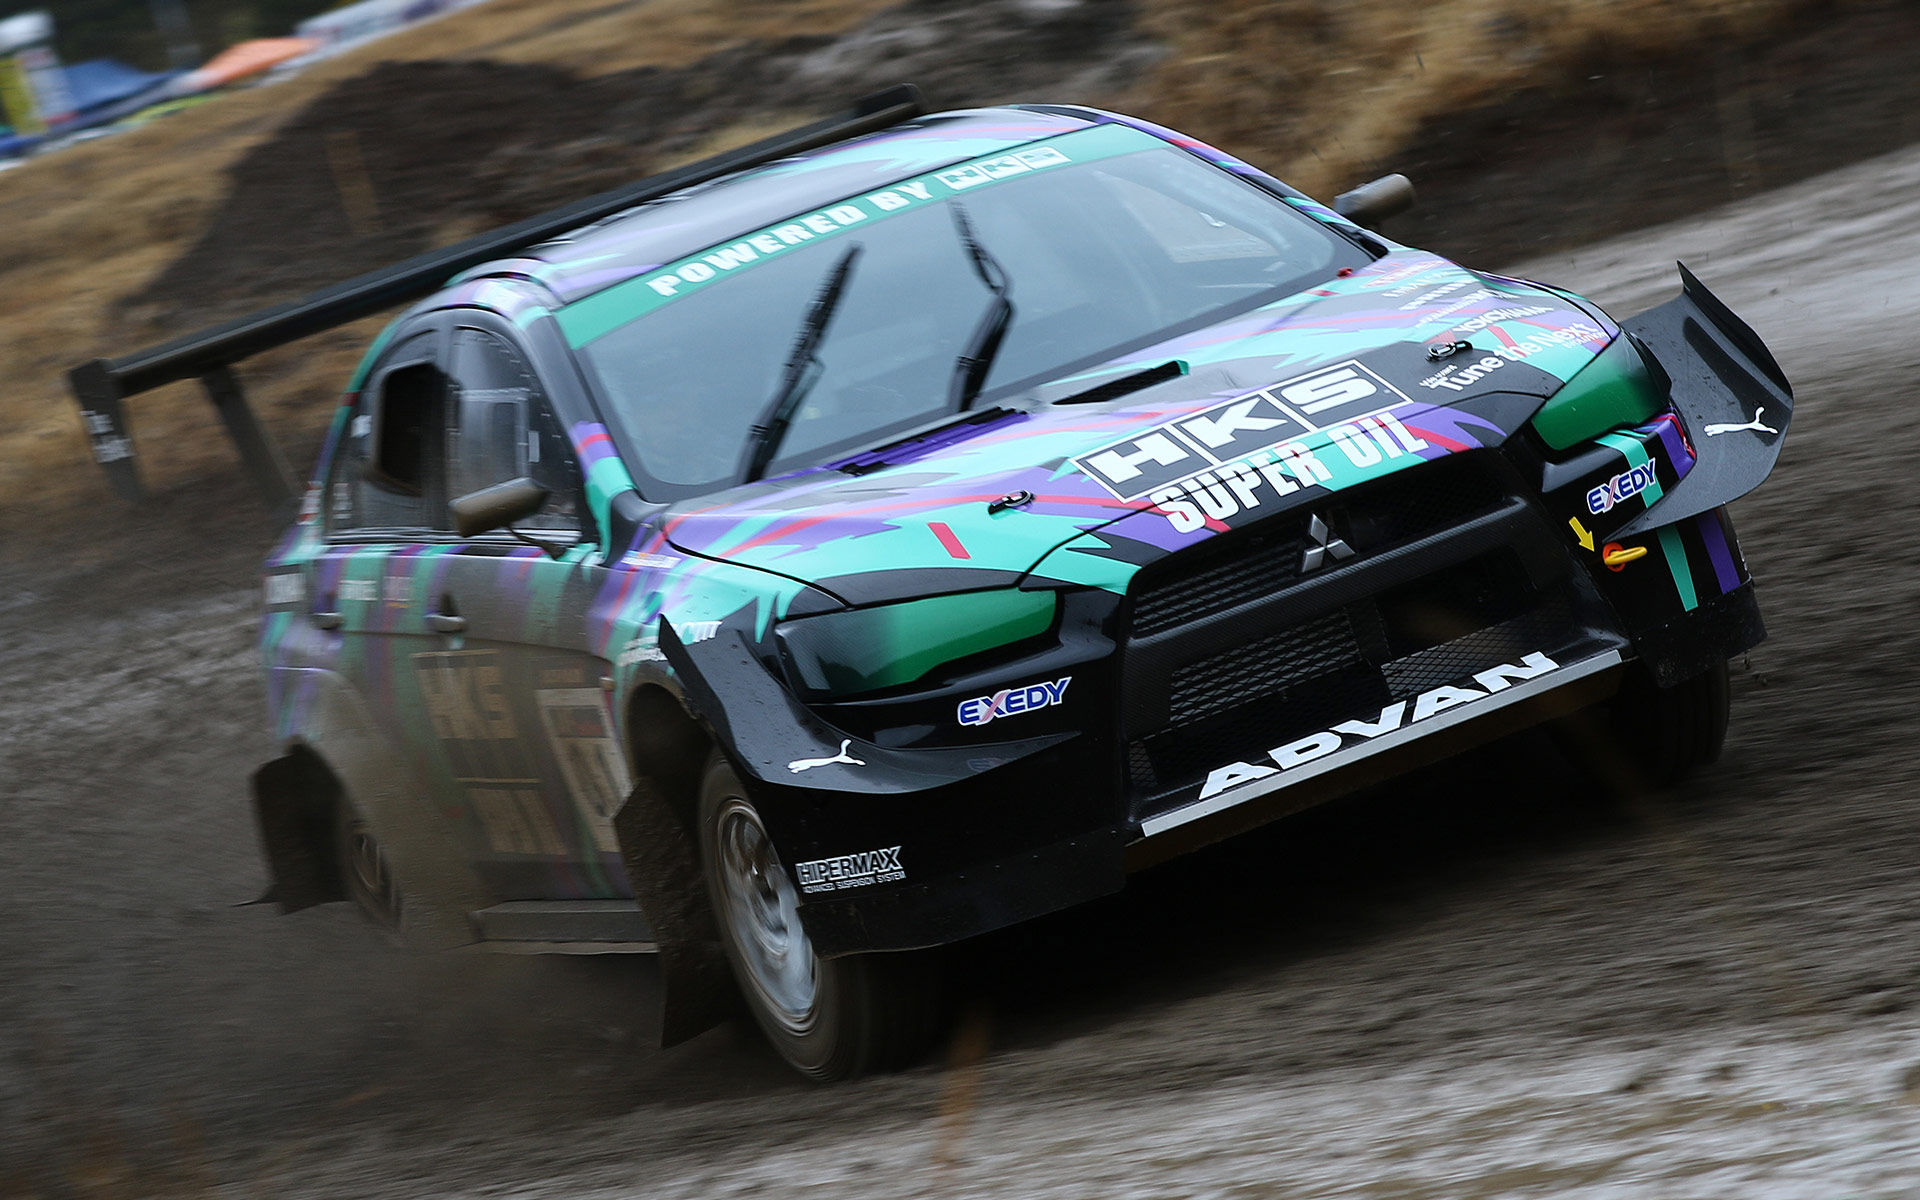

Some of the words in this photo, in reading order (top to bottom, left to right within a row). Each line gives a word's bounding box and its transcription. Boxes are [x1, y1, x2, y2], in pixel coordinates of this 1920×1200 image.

[646, 204, 867, 297] POWERED
[866, 181, 933, 211] BY
[1430, 356, 1506, 391] Tune
[1494, 338, 1543, 362] the
[1526, 322, 1599, 348] Next
[1080, 364, 1384, 488] HKS
[1149, 441, 1333, 533] SUPER
[1326, 411, 1430, 469] OIL
[1587, 458, 1656, 515] EXEDY
[958, 677, 1072, 726] EXEDY
[1199, 651, 1560, 800] ADVAN
[795, 845, 903, 885] HIPERMAX
